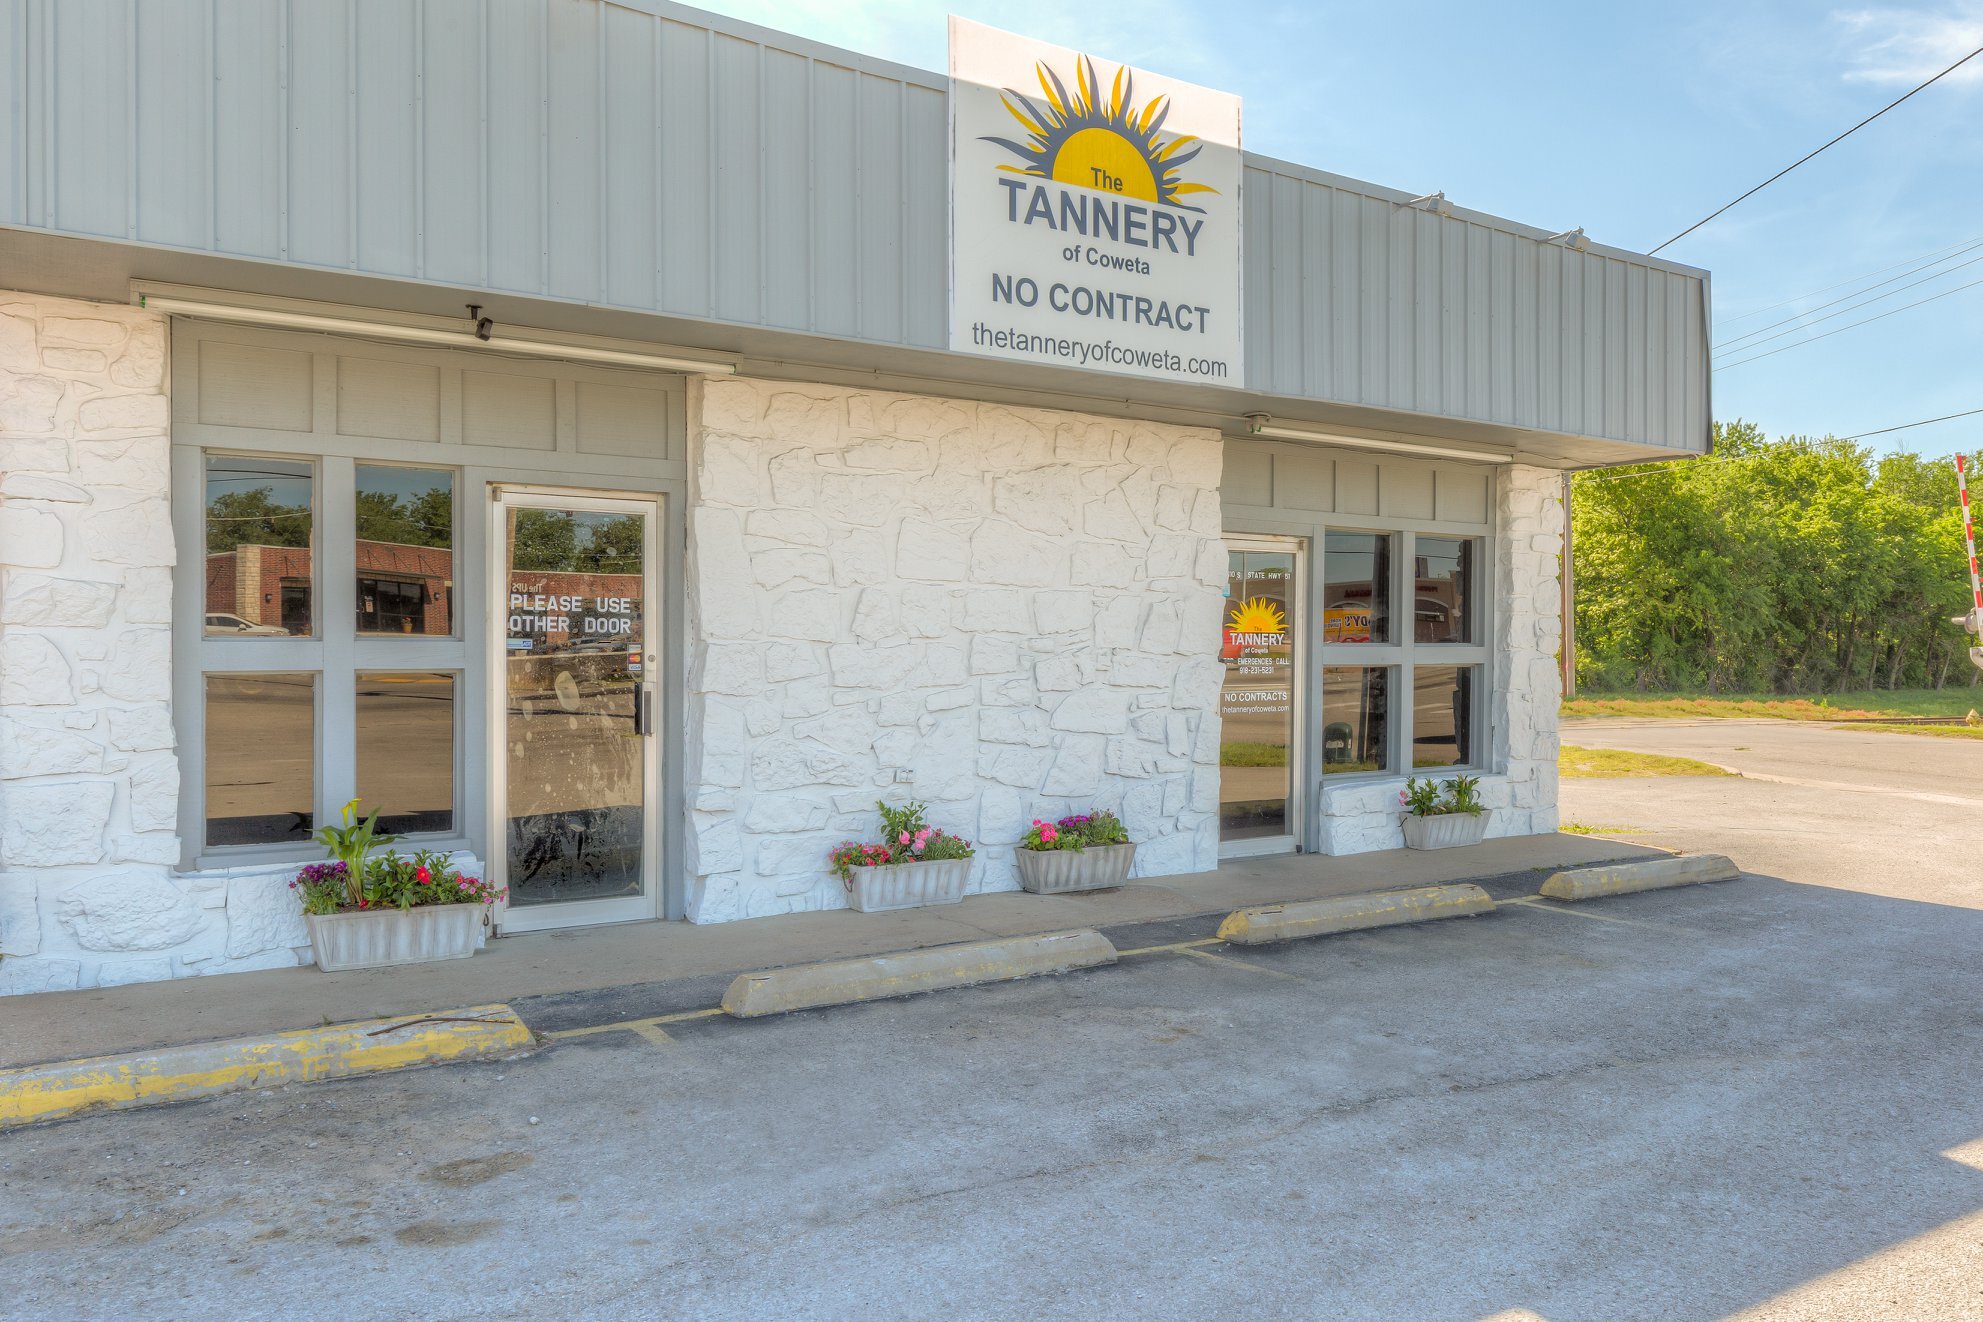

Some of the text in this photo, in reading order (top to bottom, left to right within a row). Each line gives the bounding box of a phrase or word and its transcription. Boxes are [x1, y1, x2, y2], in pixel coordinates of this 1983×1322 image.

[1090, 166, 1123, 192] The
[998, 177, 1204, 257] TANNERY
[1062, 245, 1150, 275] of Coweta
[992, 272, 1210, 334] NO CONTRACT
[972, 322, 1227, 378] thetanneryofcoweta.com
[1247, 571, 1266, 580] STATE
[1268, 572, 1282, 580] HWY
[510, 593, 631, 614] PLEASE USE
[509, 615, 631, 634] OTHER DOOR
[1229, 633, 1285, 646] TANNERY
[1237, 657, 1273, 665] EMERGENCIES
[1275, 657, 1290, 665] CALL
[1224, 691, 1288, 702] NO CONTRACTS
[1221, 705, 1290, 714] thetanneryofcoweta.com
